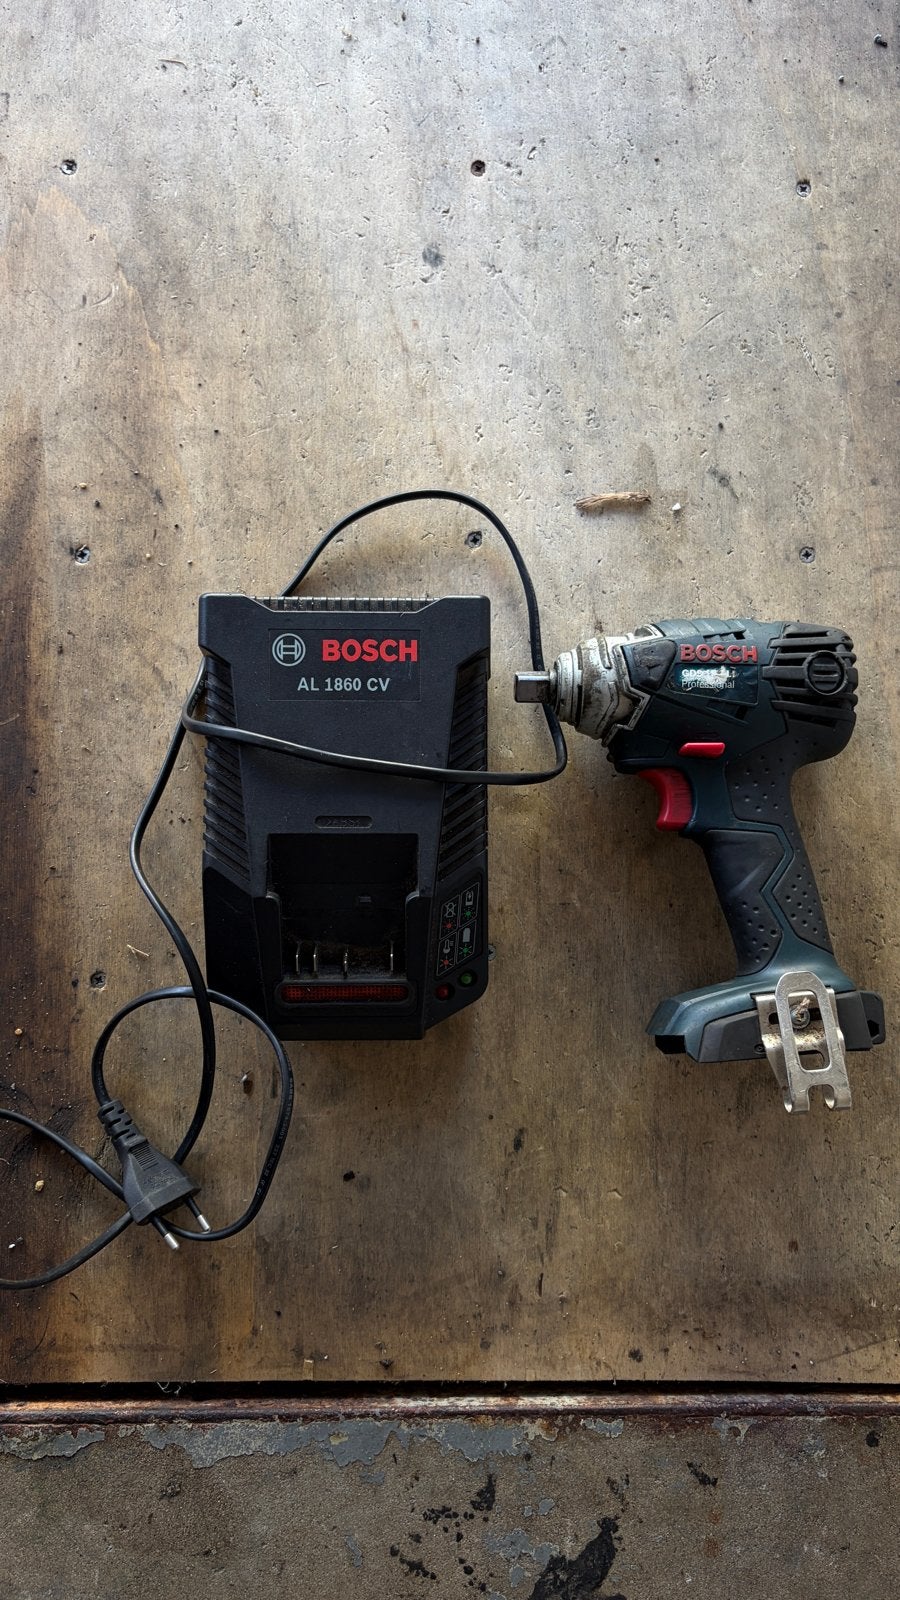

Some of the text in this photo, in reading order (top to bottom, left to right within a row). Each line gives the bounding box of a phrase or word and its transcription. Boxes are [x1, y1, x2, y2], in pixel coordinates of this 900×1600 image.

[322, 639, 418, 662] BOSCH
[680, 644, 758, 663] BOSCH
[297, 677, 390, 692] AL 1860 CV
